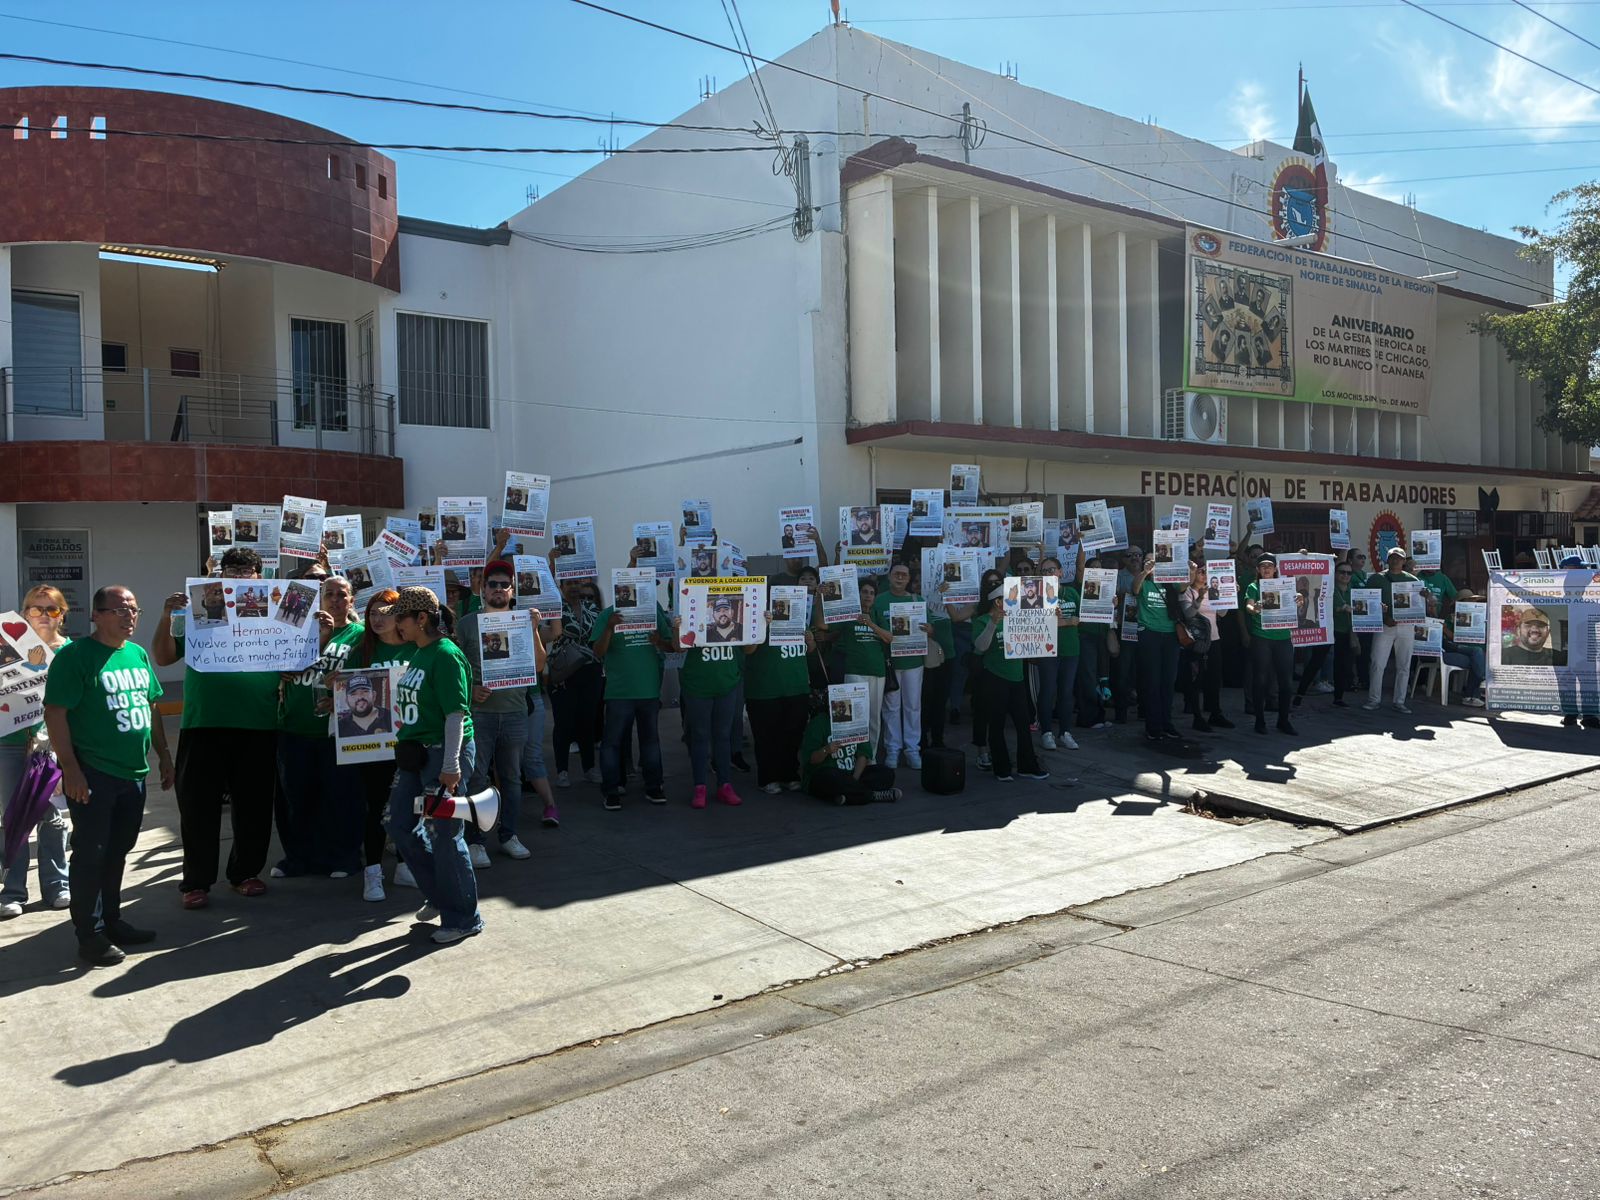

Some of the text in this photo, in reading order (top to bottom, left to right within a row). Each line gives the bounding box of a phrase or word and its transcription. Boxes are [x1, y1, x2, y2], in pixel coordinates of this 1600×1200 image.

[1228, 240, 1435, 295] FEDERACION DE TRABAJADORES DE LA REGION
[1300, 269, 1383, 295] NORTE DE SINALOA
[1331, 315, 1414, 340] ANIVERSARIO
[1313, 327, 1427, 355] DE LA GESTA HEROICA DE
[1305, 339, 1431, 369] LOS MARTIRES DE CHICAGO,
[1313, 354, 1330, 365] RIO
[1333, 357, 1373, 371] BLANCO
[1381, 364, 1425, 379] CANANEA
[1321, 390, 1336, 398] LOS
[1400, 401, 1419, 409] MAYO
[1141, 471, 1456, 506] FEDERACION DE TRABAJADORES
[29, 543, 82, 552] ABOGADOS
[1284, 562, 1325, 570] DESAPARECIDO
[188, 635, 319, 652] Vuelve pronto por favor
[322, 642, 352, 660] AR
[1014, 641, 1043, 657] OMAR
[192, 655, 210, 667] Me
[213, 653, 245, 664] haces
[702, 645, 735, 662] SOLO
[3, 669, 21, 678] TE
[400, 667, 425, 690] AR
[24, 693, 42, 704] DE
[106, 692, 130, 711] NO
[397, 686, 419, 706] STA
[341, 742, 381, 753] SEGUIMOS
[836, 756, 855, 771] SO
